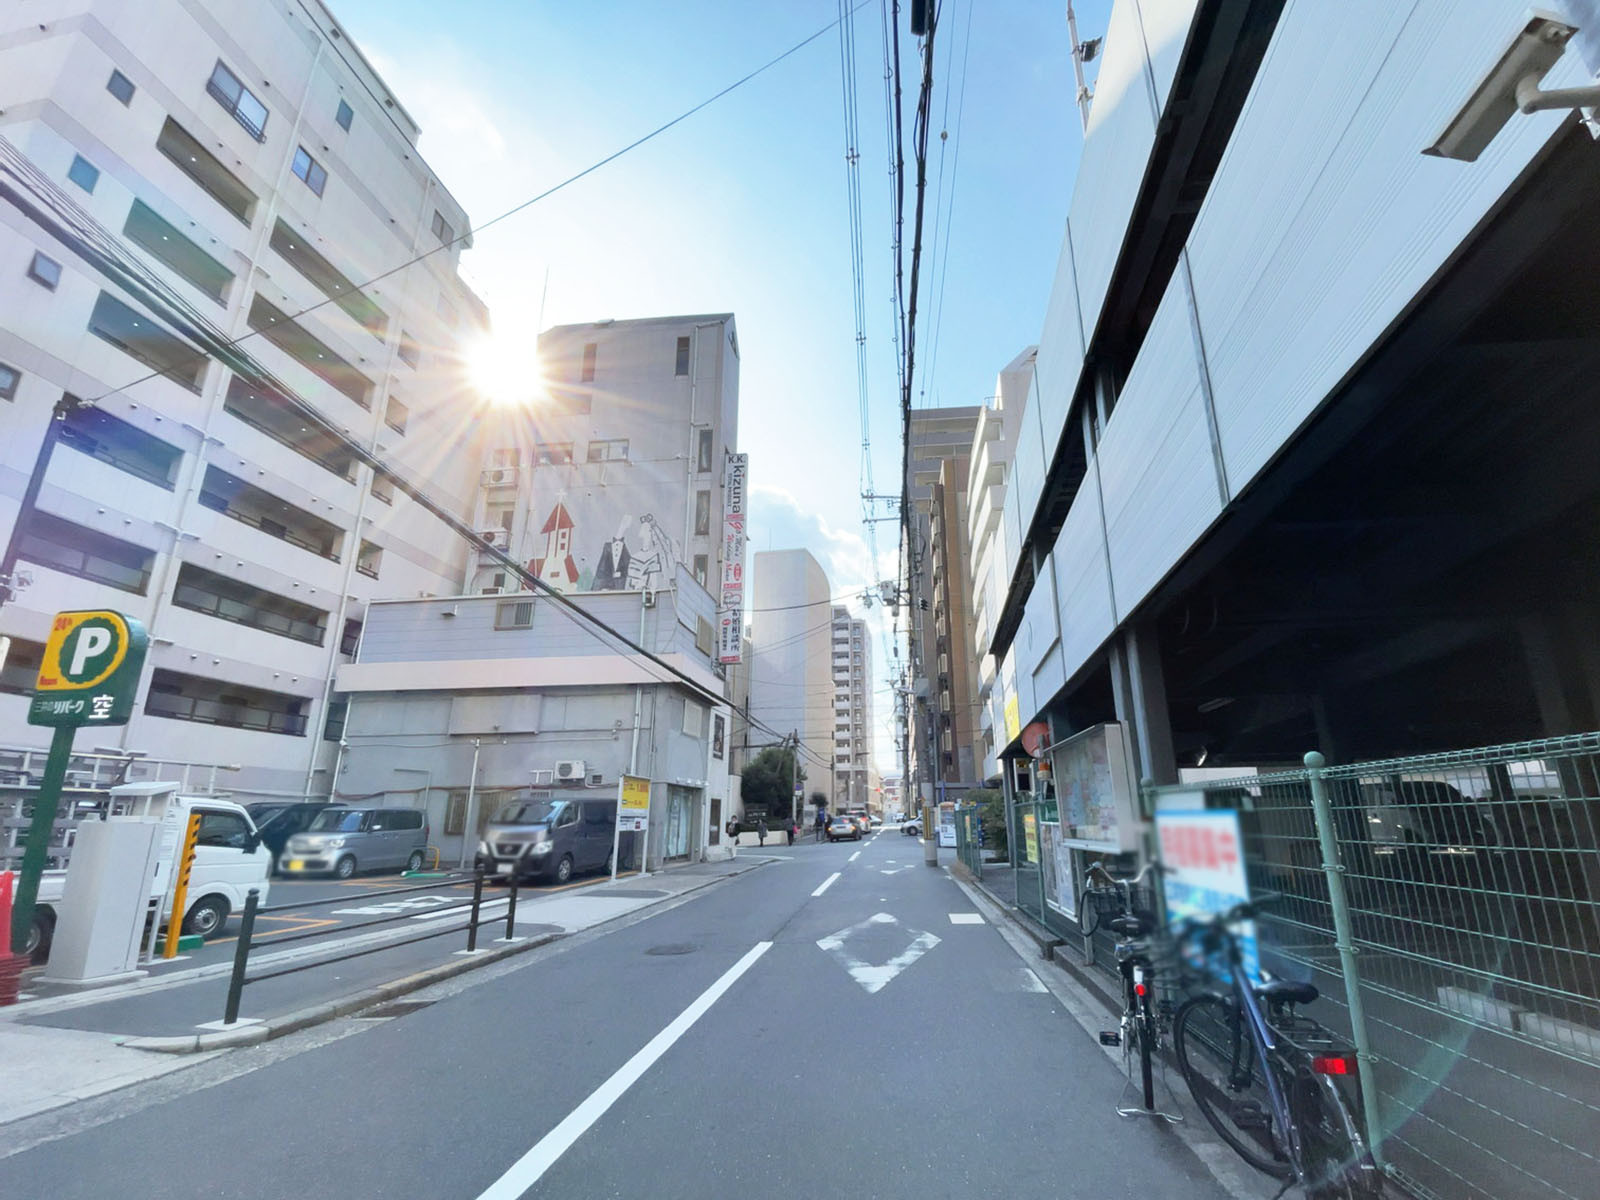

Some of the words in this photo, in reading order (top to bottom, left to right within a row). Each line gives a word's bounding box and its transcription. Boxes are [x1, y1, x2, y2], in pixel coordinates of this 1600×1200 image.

[732, 465, 745, 514] kizuna
[69, 627, 111, 675] P
[88, 694, 114, 719] 空
